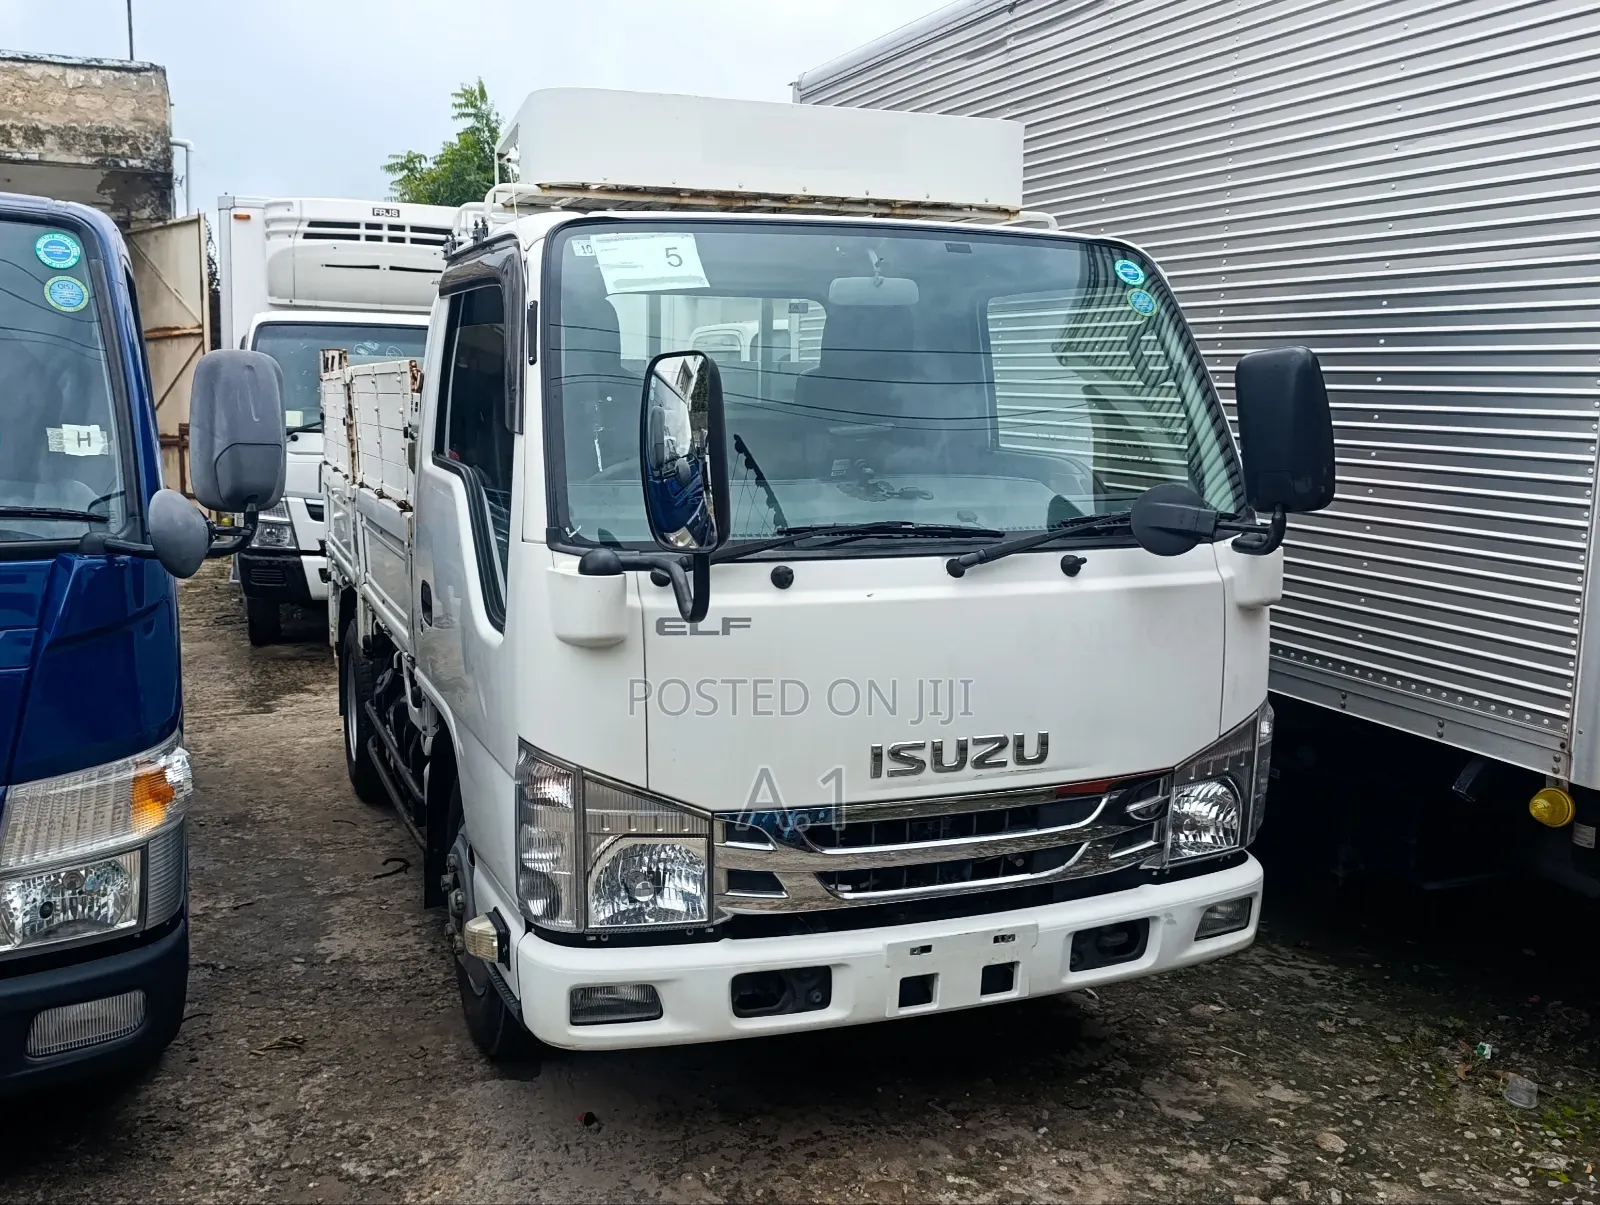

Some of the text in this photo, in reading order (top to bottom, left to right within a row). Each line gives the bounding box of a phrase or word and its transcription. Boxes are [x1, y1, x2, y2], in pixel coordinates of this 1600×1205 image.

[580, 244, 594, 255] 10
[664, 246, 683, 268] 5
[77, 430, 91, 448] H
[655, 616, 752, 636] ELF
[869, 729, 1050, 780] ISUZU
